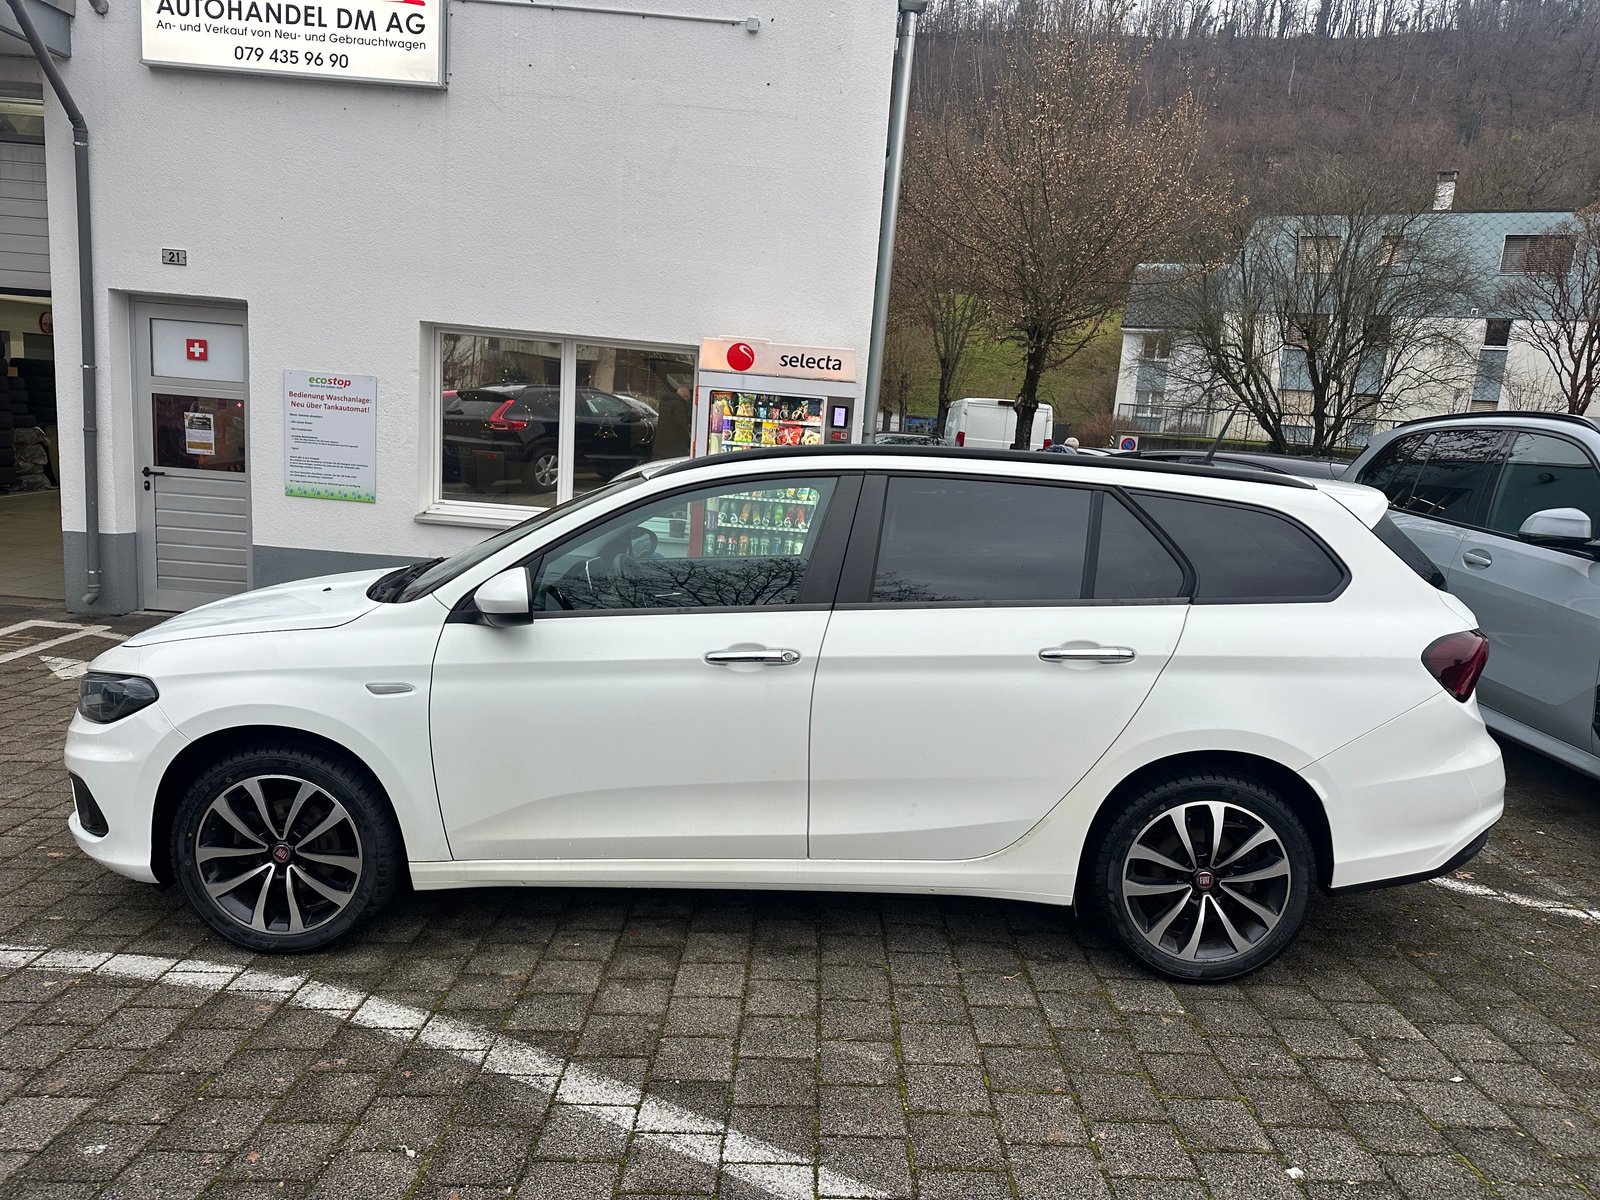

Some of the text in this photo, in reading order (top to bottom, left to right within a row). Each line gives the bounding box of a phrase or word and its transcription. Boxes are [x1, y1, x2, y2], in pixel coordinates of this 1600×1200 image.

[156, 0, 426, 35] AUTOHANDEL DM AG
[156, 19, 427, 51] An- und Verkauf von Neu- und Gebrauchtwagen
[234, 45, 349, 69] 079 435 96 90
[168, 252, 180, 262] 21
[778, 353, 843, 371] selecta
[308, 376, 352, 389] ecostop
[288, 390, 372, 404] Bedienung Waschanlage:
[290, 400, 370, 414] Neu über Tankautomat!
[1199, 876, 1210, 885] FIAT
